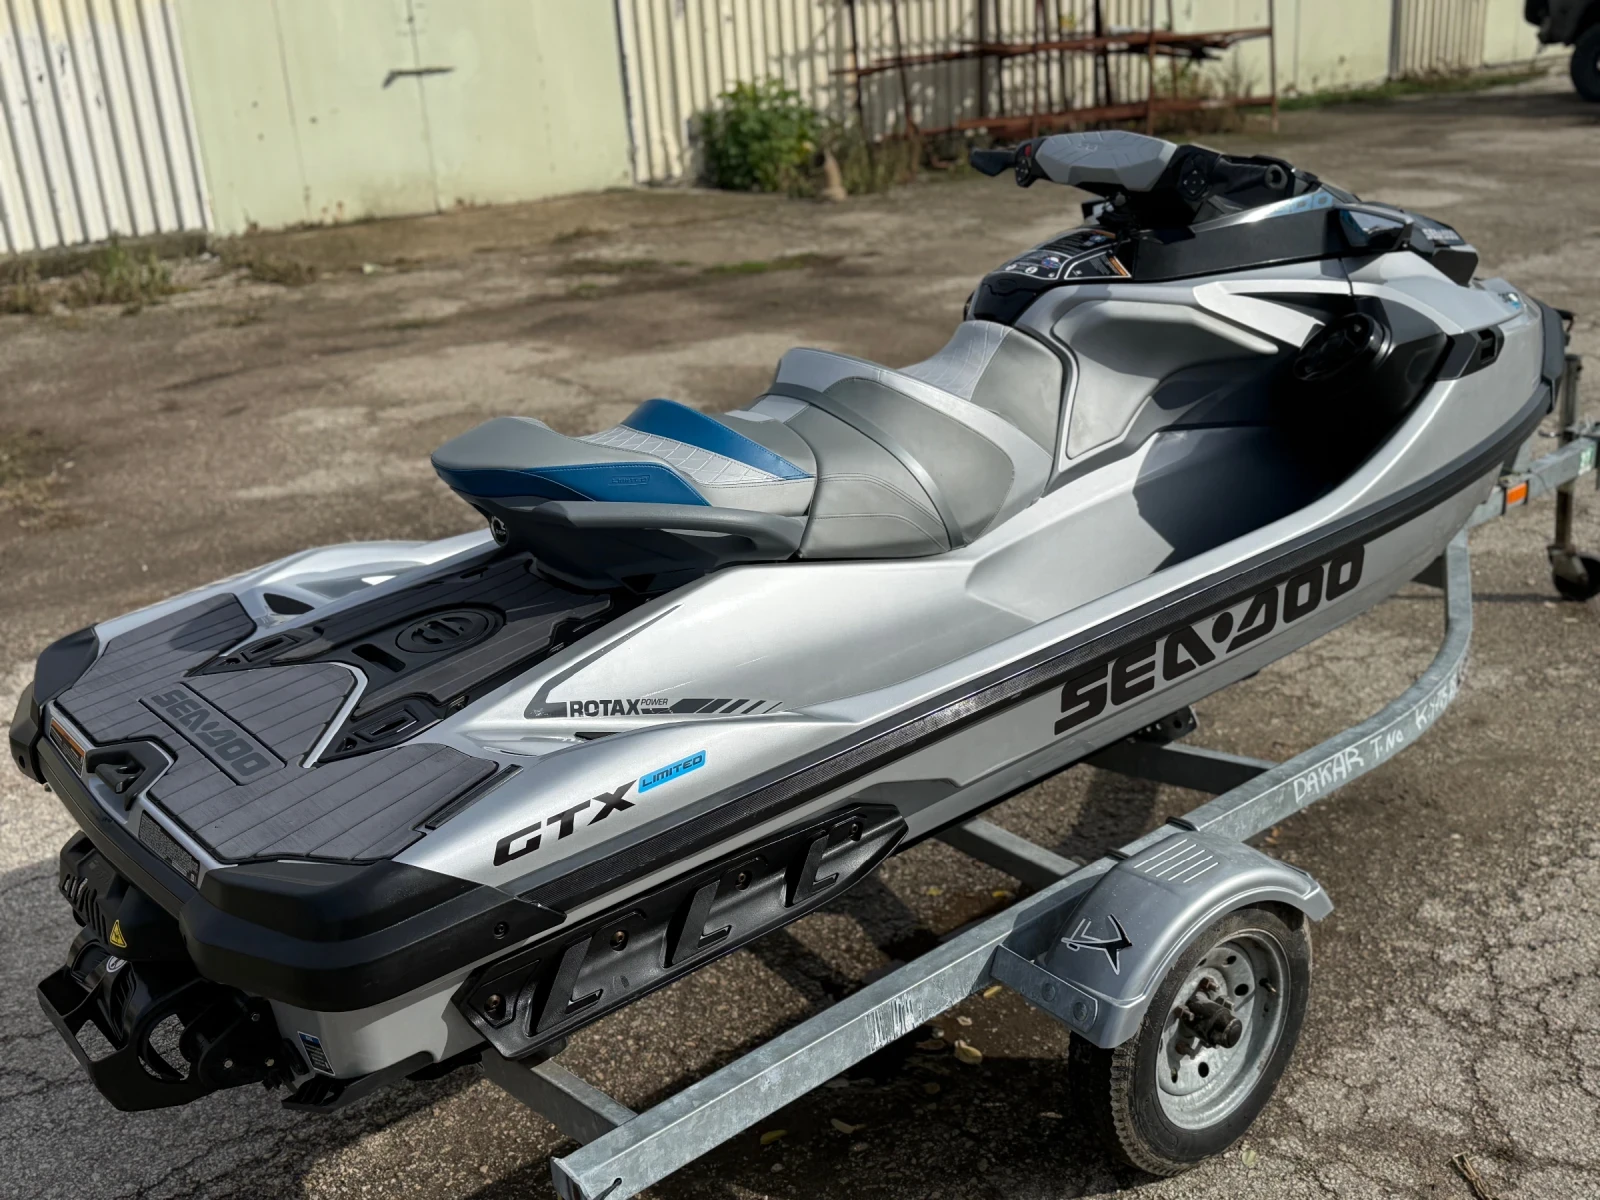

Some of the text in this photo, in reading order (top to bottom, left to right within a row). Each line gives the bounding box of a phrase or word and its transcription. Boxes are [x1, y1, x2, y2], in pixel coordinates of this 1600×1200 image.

[569, 698, 669, 718] ROTAX POWER
[1293, 746, 1365, 804] DAKAR
[493, 754, 703, 866] GTX LIMITED
